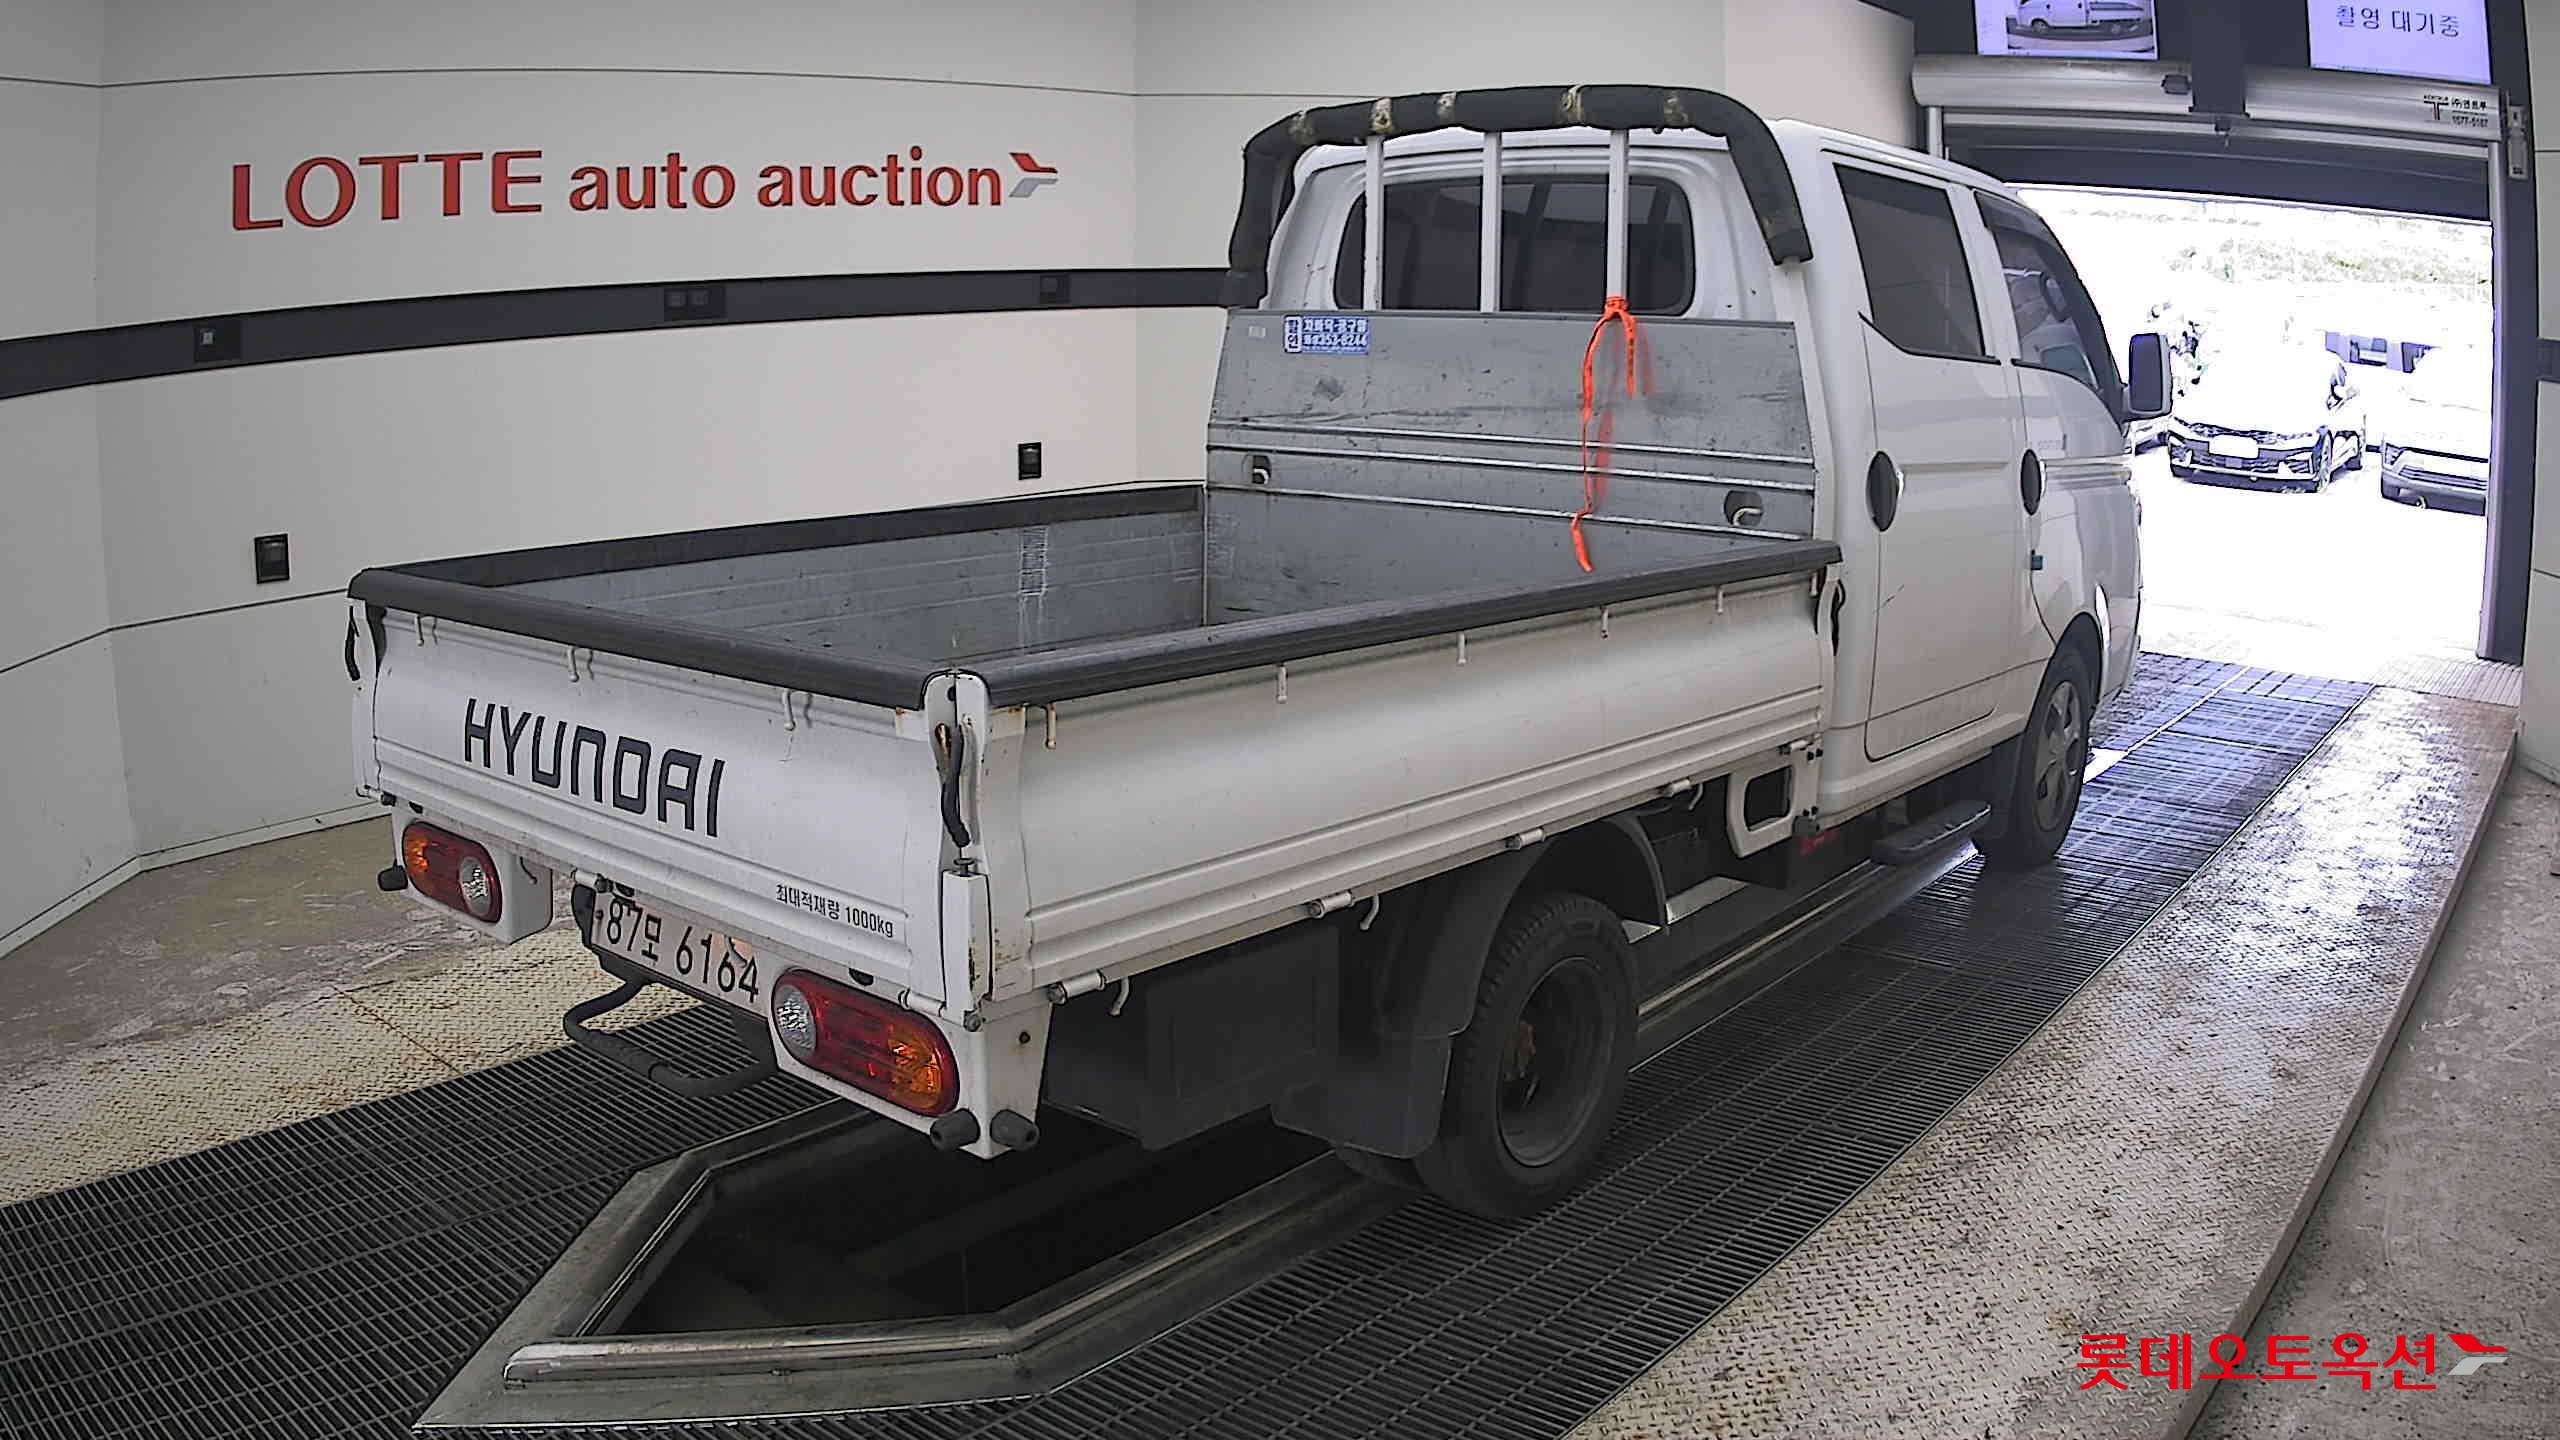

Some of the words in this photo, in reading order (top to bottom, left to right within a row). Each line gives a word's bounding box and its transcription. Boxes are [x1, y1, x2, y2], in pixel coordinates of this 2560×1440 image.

[2336, 5, 2380, 30] 촬영
[2391, 10, 2460, 38] 대기중
[232, 149, 543, 232] LOTTE
[568, 151, 737, 211] auto
[756, 145, 1003, 210] auction
[464, 697, 726, 838] HYUNDAI
[606, 898, 663, 963] 87모
[675, 925, 759, 1004] 6164
[775, 883, 841, 921] 최대적재량
[845, 906, 894, 938] 1000kg
